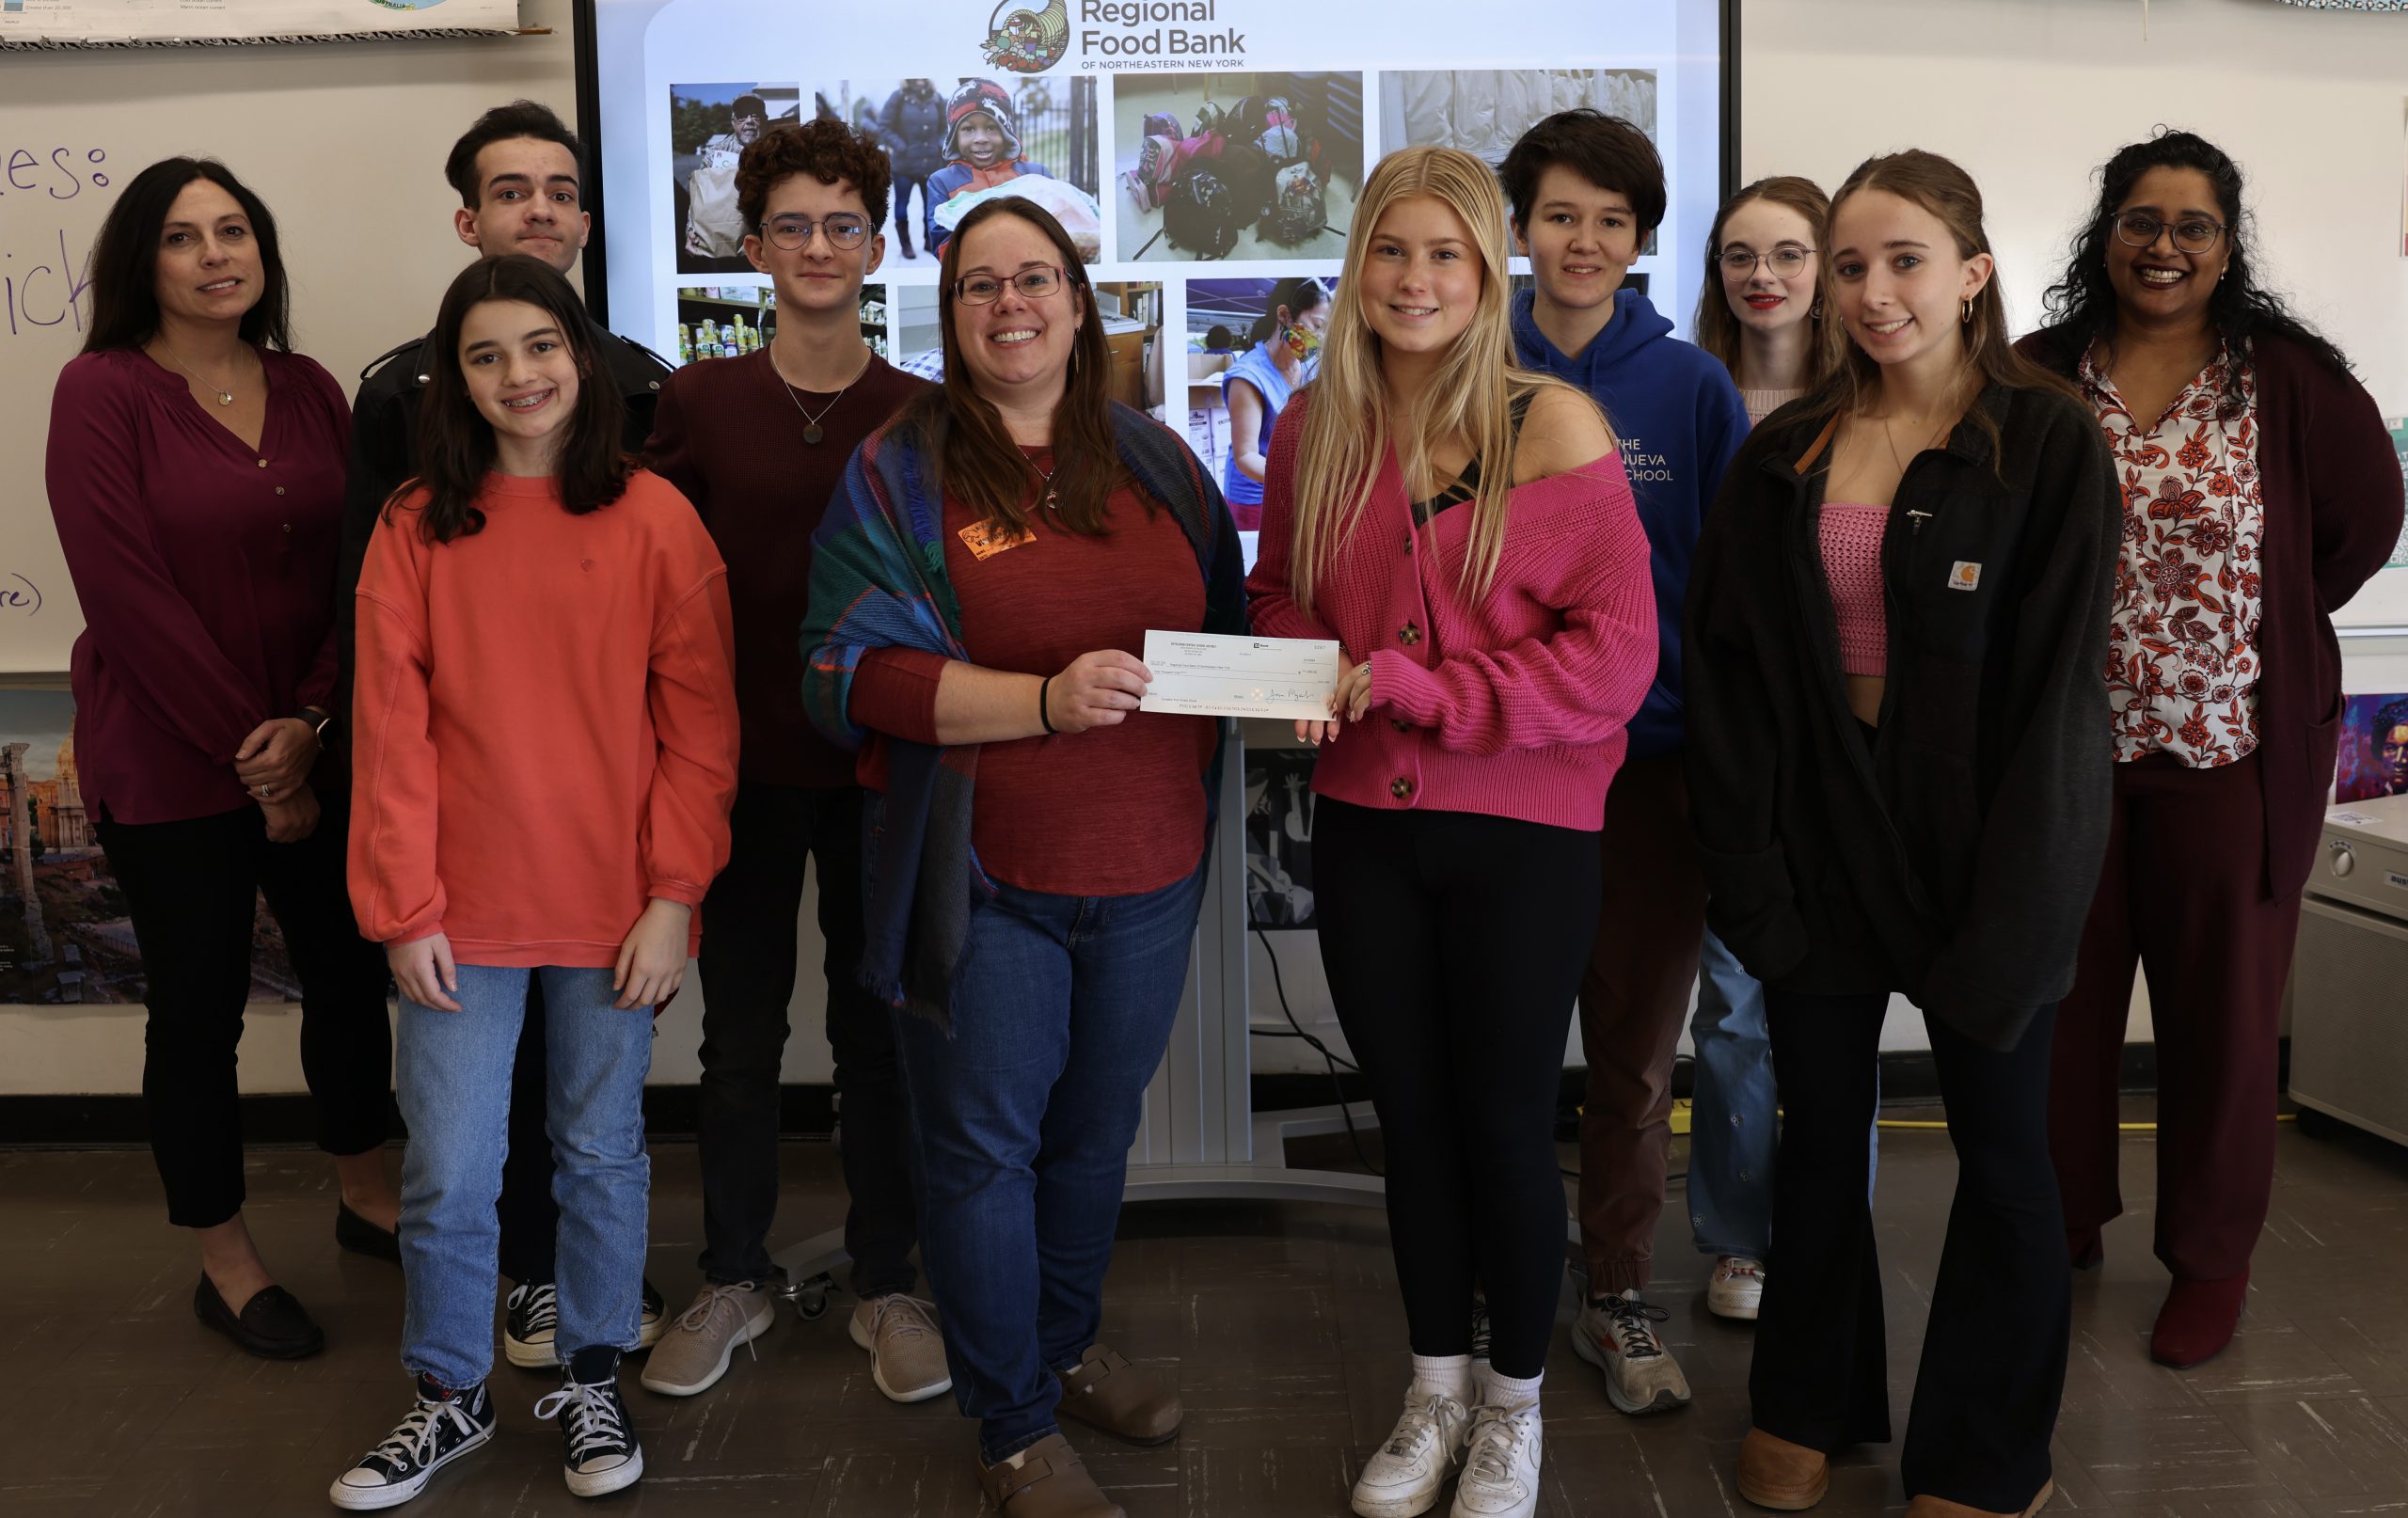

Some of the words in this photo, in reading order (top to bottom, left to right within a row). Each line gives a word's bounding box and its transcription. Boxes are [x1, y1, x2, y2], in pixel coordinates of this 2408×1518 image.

[1082, 0, 1214, 27] Regional
[1082, 28, 1161, 55] Food
[1169, 27, 1246, 55] Bank
[1082, 61, 1096, 70] OF
[1099, 60, 1184, 69] NORTHEASTERN
[1188, 59, 1212, 68] NEW
[1214, 59, 1244, 68] YORK
[0, 148, 109, 199] es:
[1616, 438, 1640, 451] THE
[1624, 469, 1673, 482] CHOOL
[2391, 876, 2408, 885] aus
